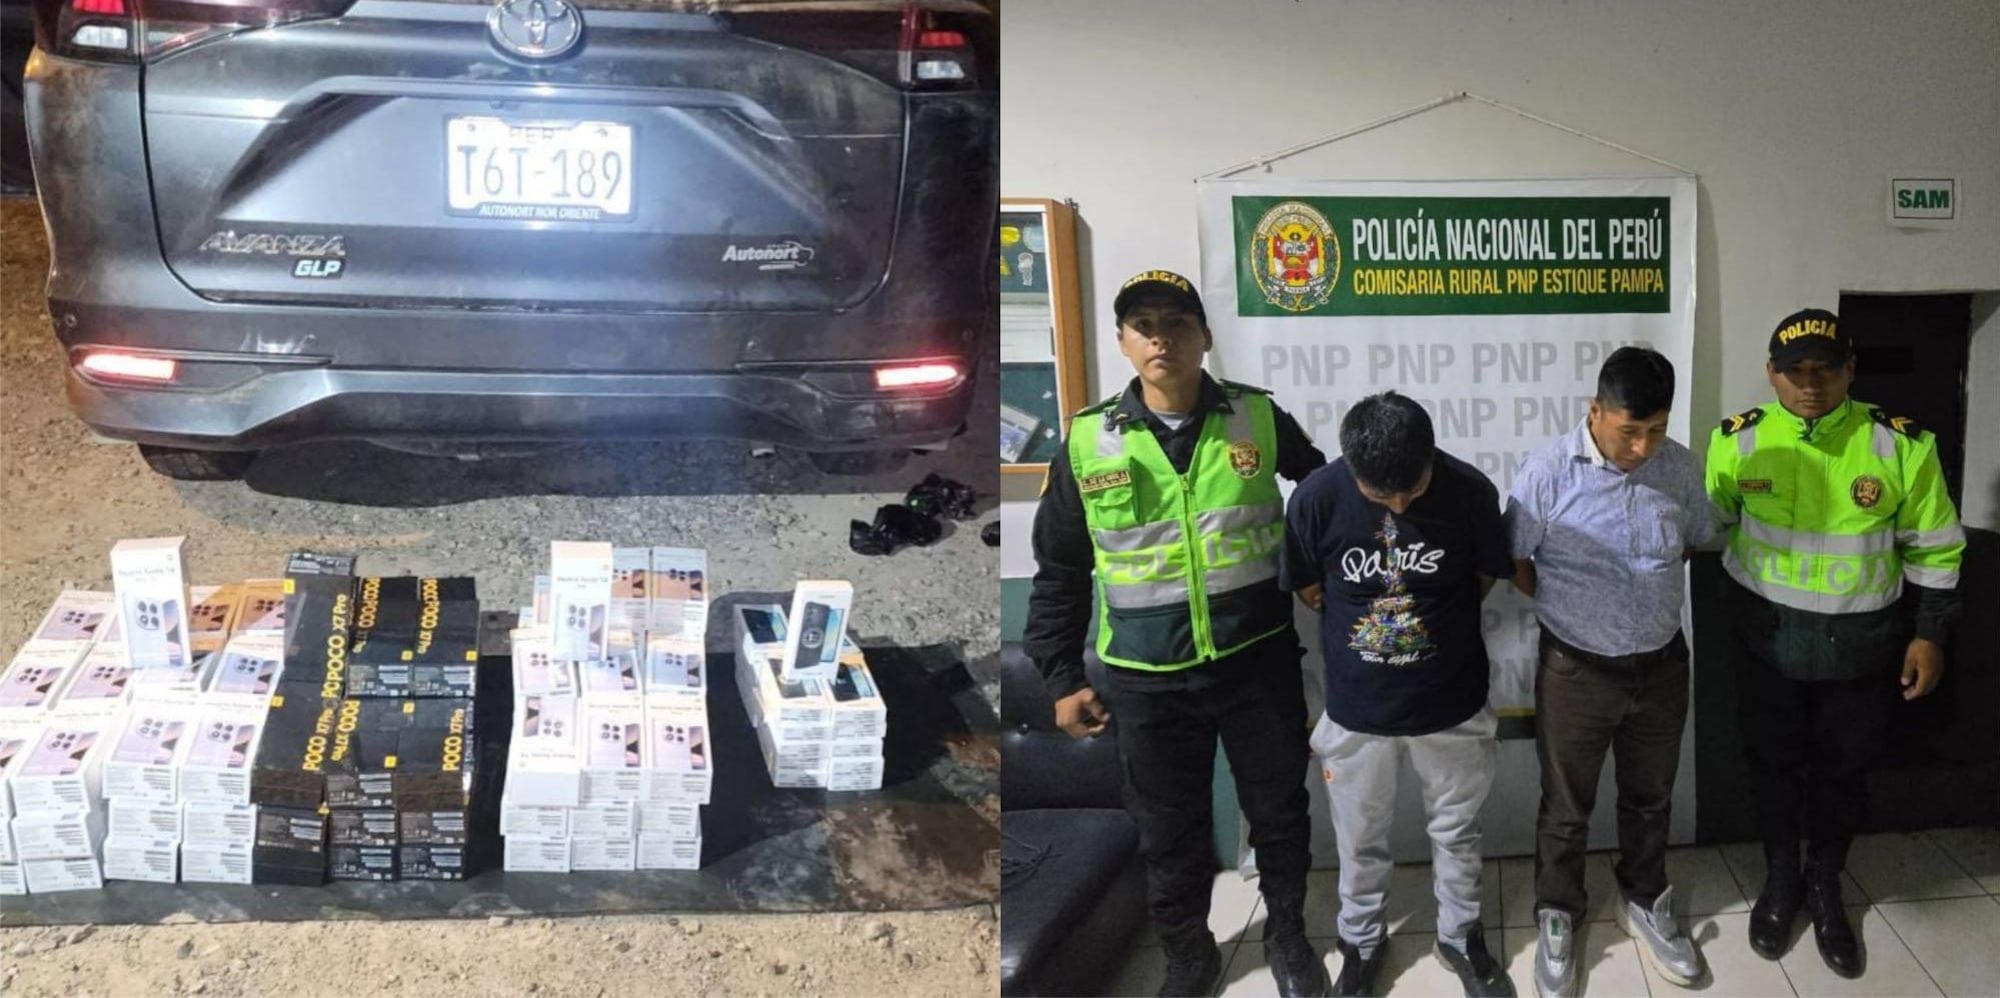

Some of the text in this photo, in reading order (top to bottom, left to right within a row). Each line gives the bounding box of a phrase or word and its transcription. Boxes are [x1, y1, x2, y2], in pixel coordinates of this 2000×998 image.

[456, 144, 622, 200] T6T-189
[479, 203, 600, 220] AUTONORT NOR ORIENTE
[1897, 188, 1950, 209] SAM
[198, 230, 346, 257] AVANZA
[1352, 208, 1441, 261] POLICÍA
[1446, 217, 1556, 261] NACIONAL
[1562, 218, 1603, 260] DEL
[1608, 208, 1663, 260] PERÚ
[294, 259, 342, 277] GLP
[722, 244, 800, 262] Autonort
[1353, 268, 1445, 296] COMISARIA
[1450, 268, 1502, 295] RURAL
[1507, 268, 1539, 294] PNP
[1543, 267, 1606, 295] ESTIQUE
[1610, 267, 1664, 294] PAMPA
[1778, 319, 1837, 346] POLICIA
[1261, 344, 1351, 387] PNP
[1367, 343, 1456, 385] PNP
[1472, 342, 1558, 384] PNP
[1420, 397, 1497, 438] NP
[326, 594, 347, 681] POCO X7 Pro
[338, 700, 361, 732] POCO
[302, 735, 327, 771] POCO
[442, 736, 462, 771] POCO
